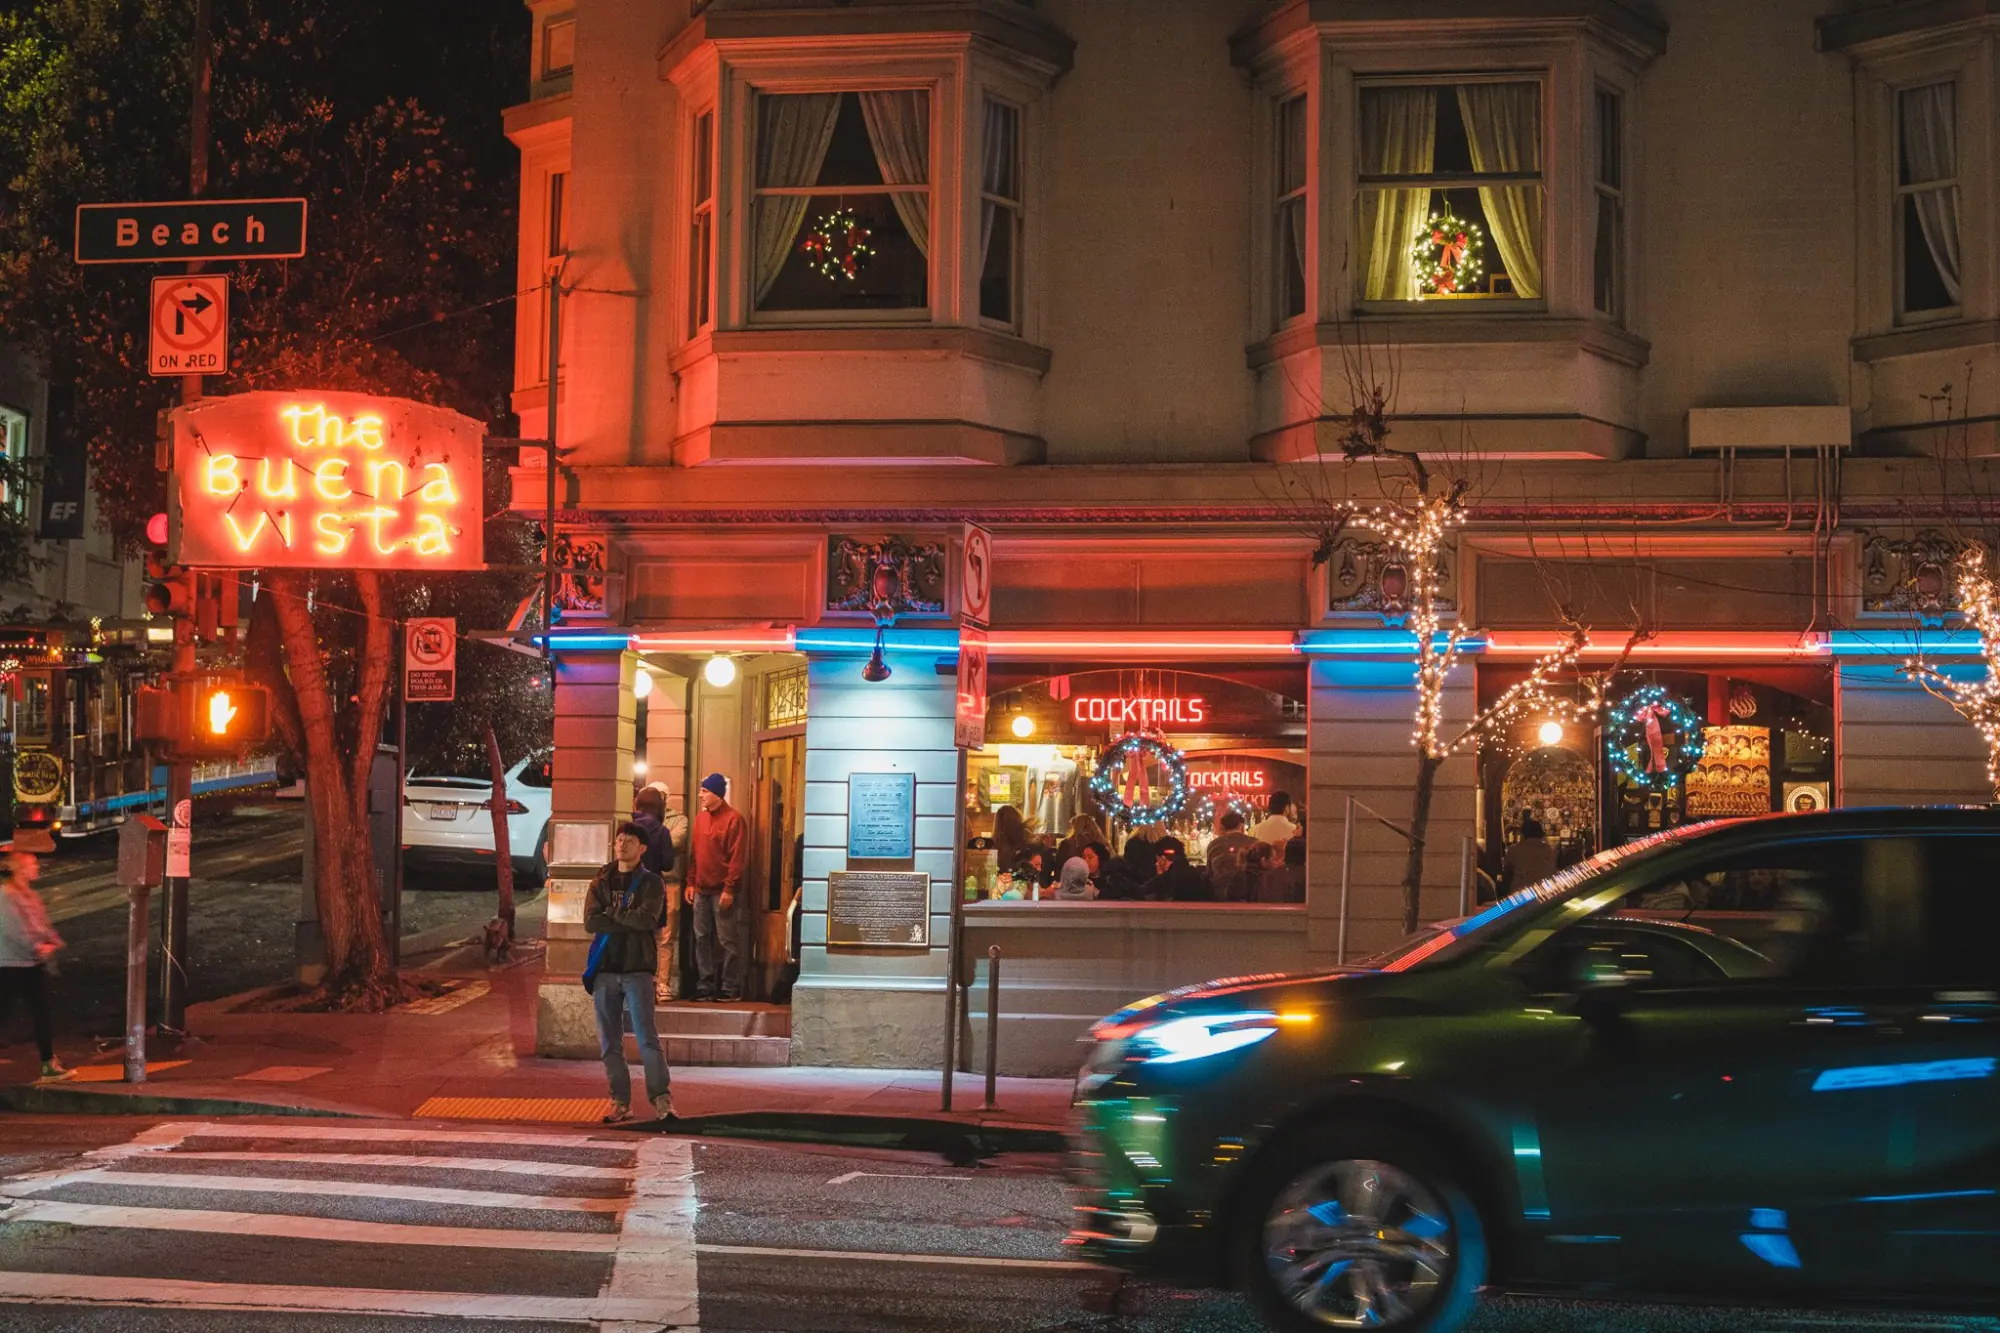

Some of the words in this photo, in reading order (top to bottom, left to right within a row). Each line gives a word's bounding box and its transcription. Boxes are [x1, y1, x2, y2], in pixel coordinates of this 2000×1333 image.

[116, 214, 265, 247] Beach
[159, 354, 179, 368] ON
[188, 353, 217, 367] RED
[50, 501, 78, 520] EF
[1074, 697, 1204, 723] COCKTAILS
